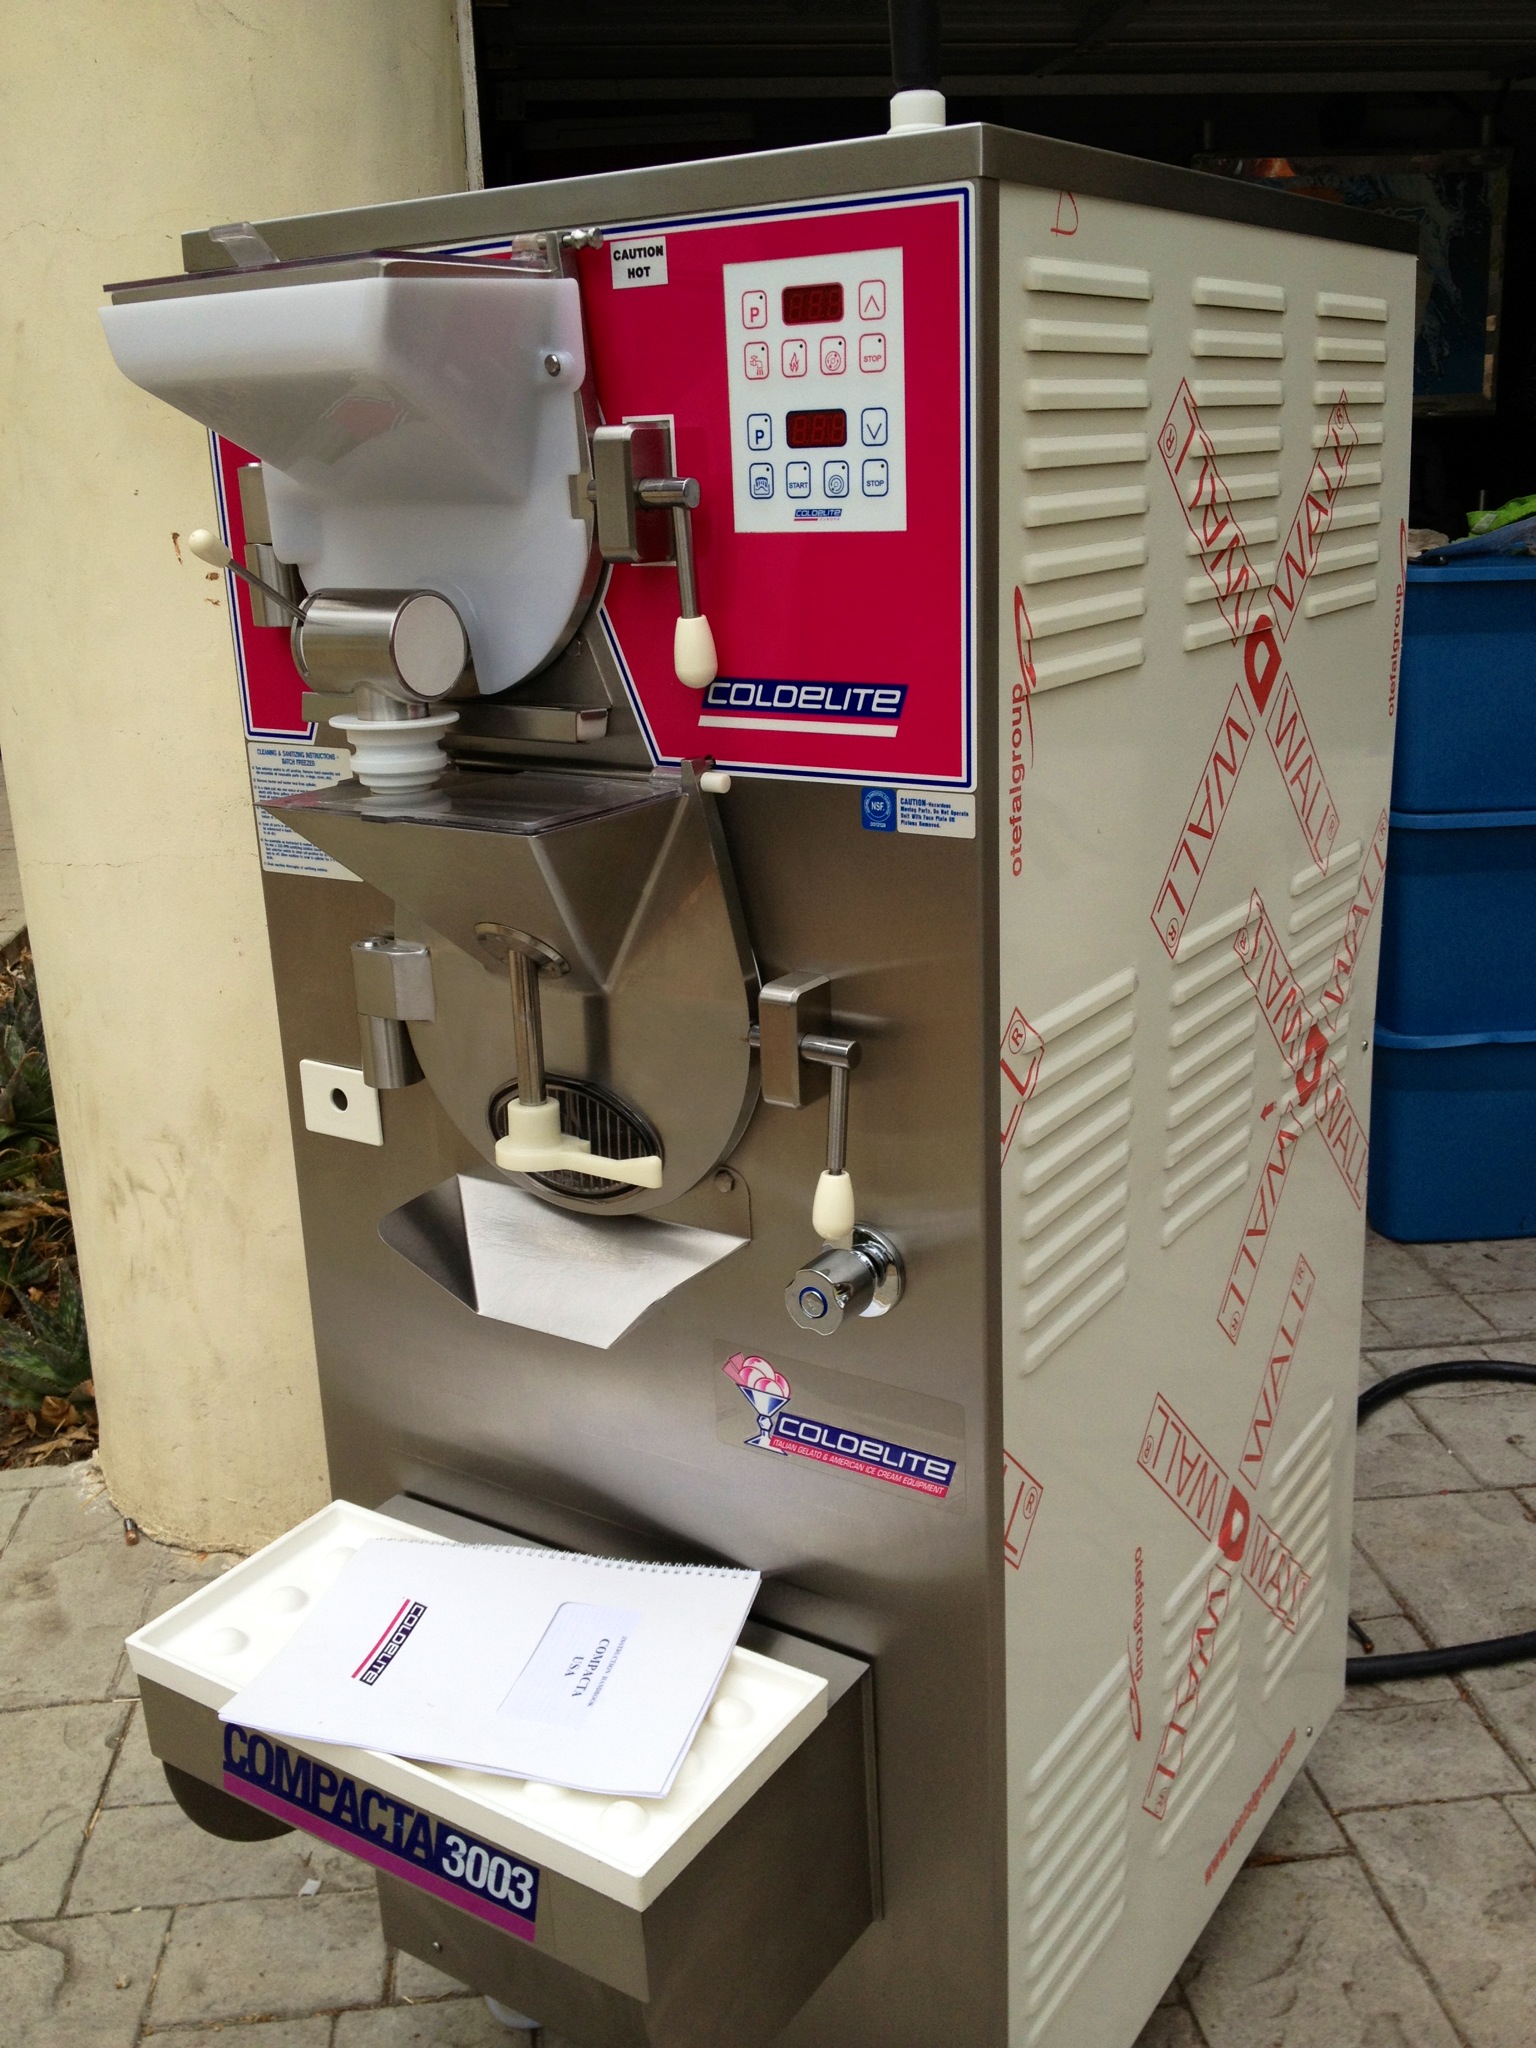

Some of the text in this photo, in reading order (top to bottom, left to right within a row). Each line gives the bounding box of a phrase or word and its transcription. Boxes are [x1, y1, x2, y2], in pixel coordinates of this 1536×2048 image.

[612, 245, 664, 261] CAUTION
[627, 266, 651, 279] HOT
[749, 306, 760, 323] P
[863, 354, 882, 363] STOP
[755, 429, 765, 445] P
[788, 481, 808, 489] START
[866, 479, 885, 488] STOP
[707, 682, 902, 713] COLDELITE
[1009, 683, 1025, 877] otefalgroup
[1275, 686, 1329, 863] WALL
[1157, 716, 1249, 917] WALL
[772, 1439, 797, 1451] ITALIAN
[797, 1445, 822, 1459] GELATO
[829, 1454, 864, 1472] AMERICAN
[865, 1465, 876, 1475] ICE
[877, 1468, 901, 1482] CREAM
[902, 1476, 945, 1495] EQUIPMENT
[778, 1417, 950, 1481] COLDELITE
[1152, 1405, 1219, 1530] WALL
[362, 1603, 426, 1685] COLDELITE
[564, 1656, 585, 1678] USA
[571, 1638, 610, 1698] COMPACTA
[223, 1722, 534, 1910] COMPACTA 3003
